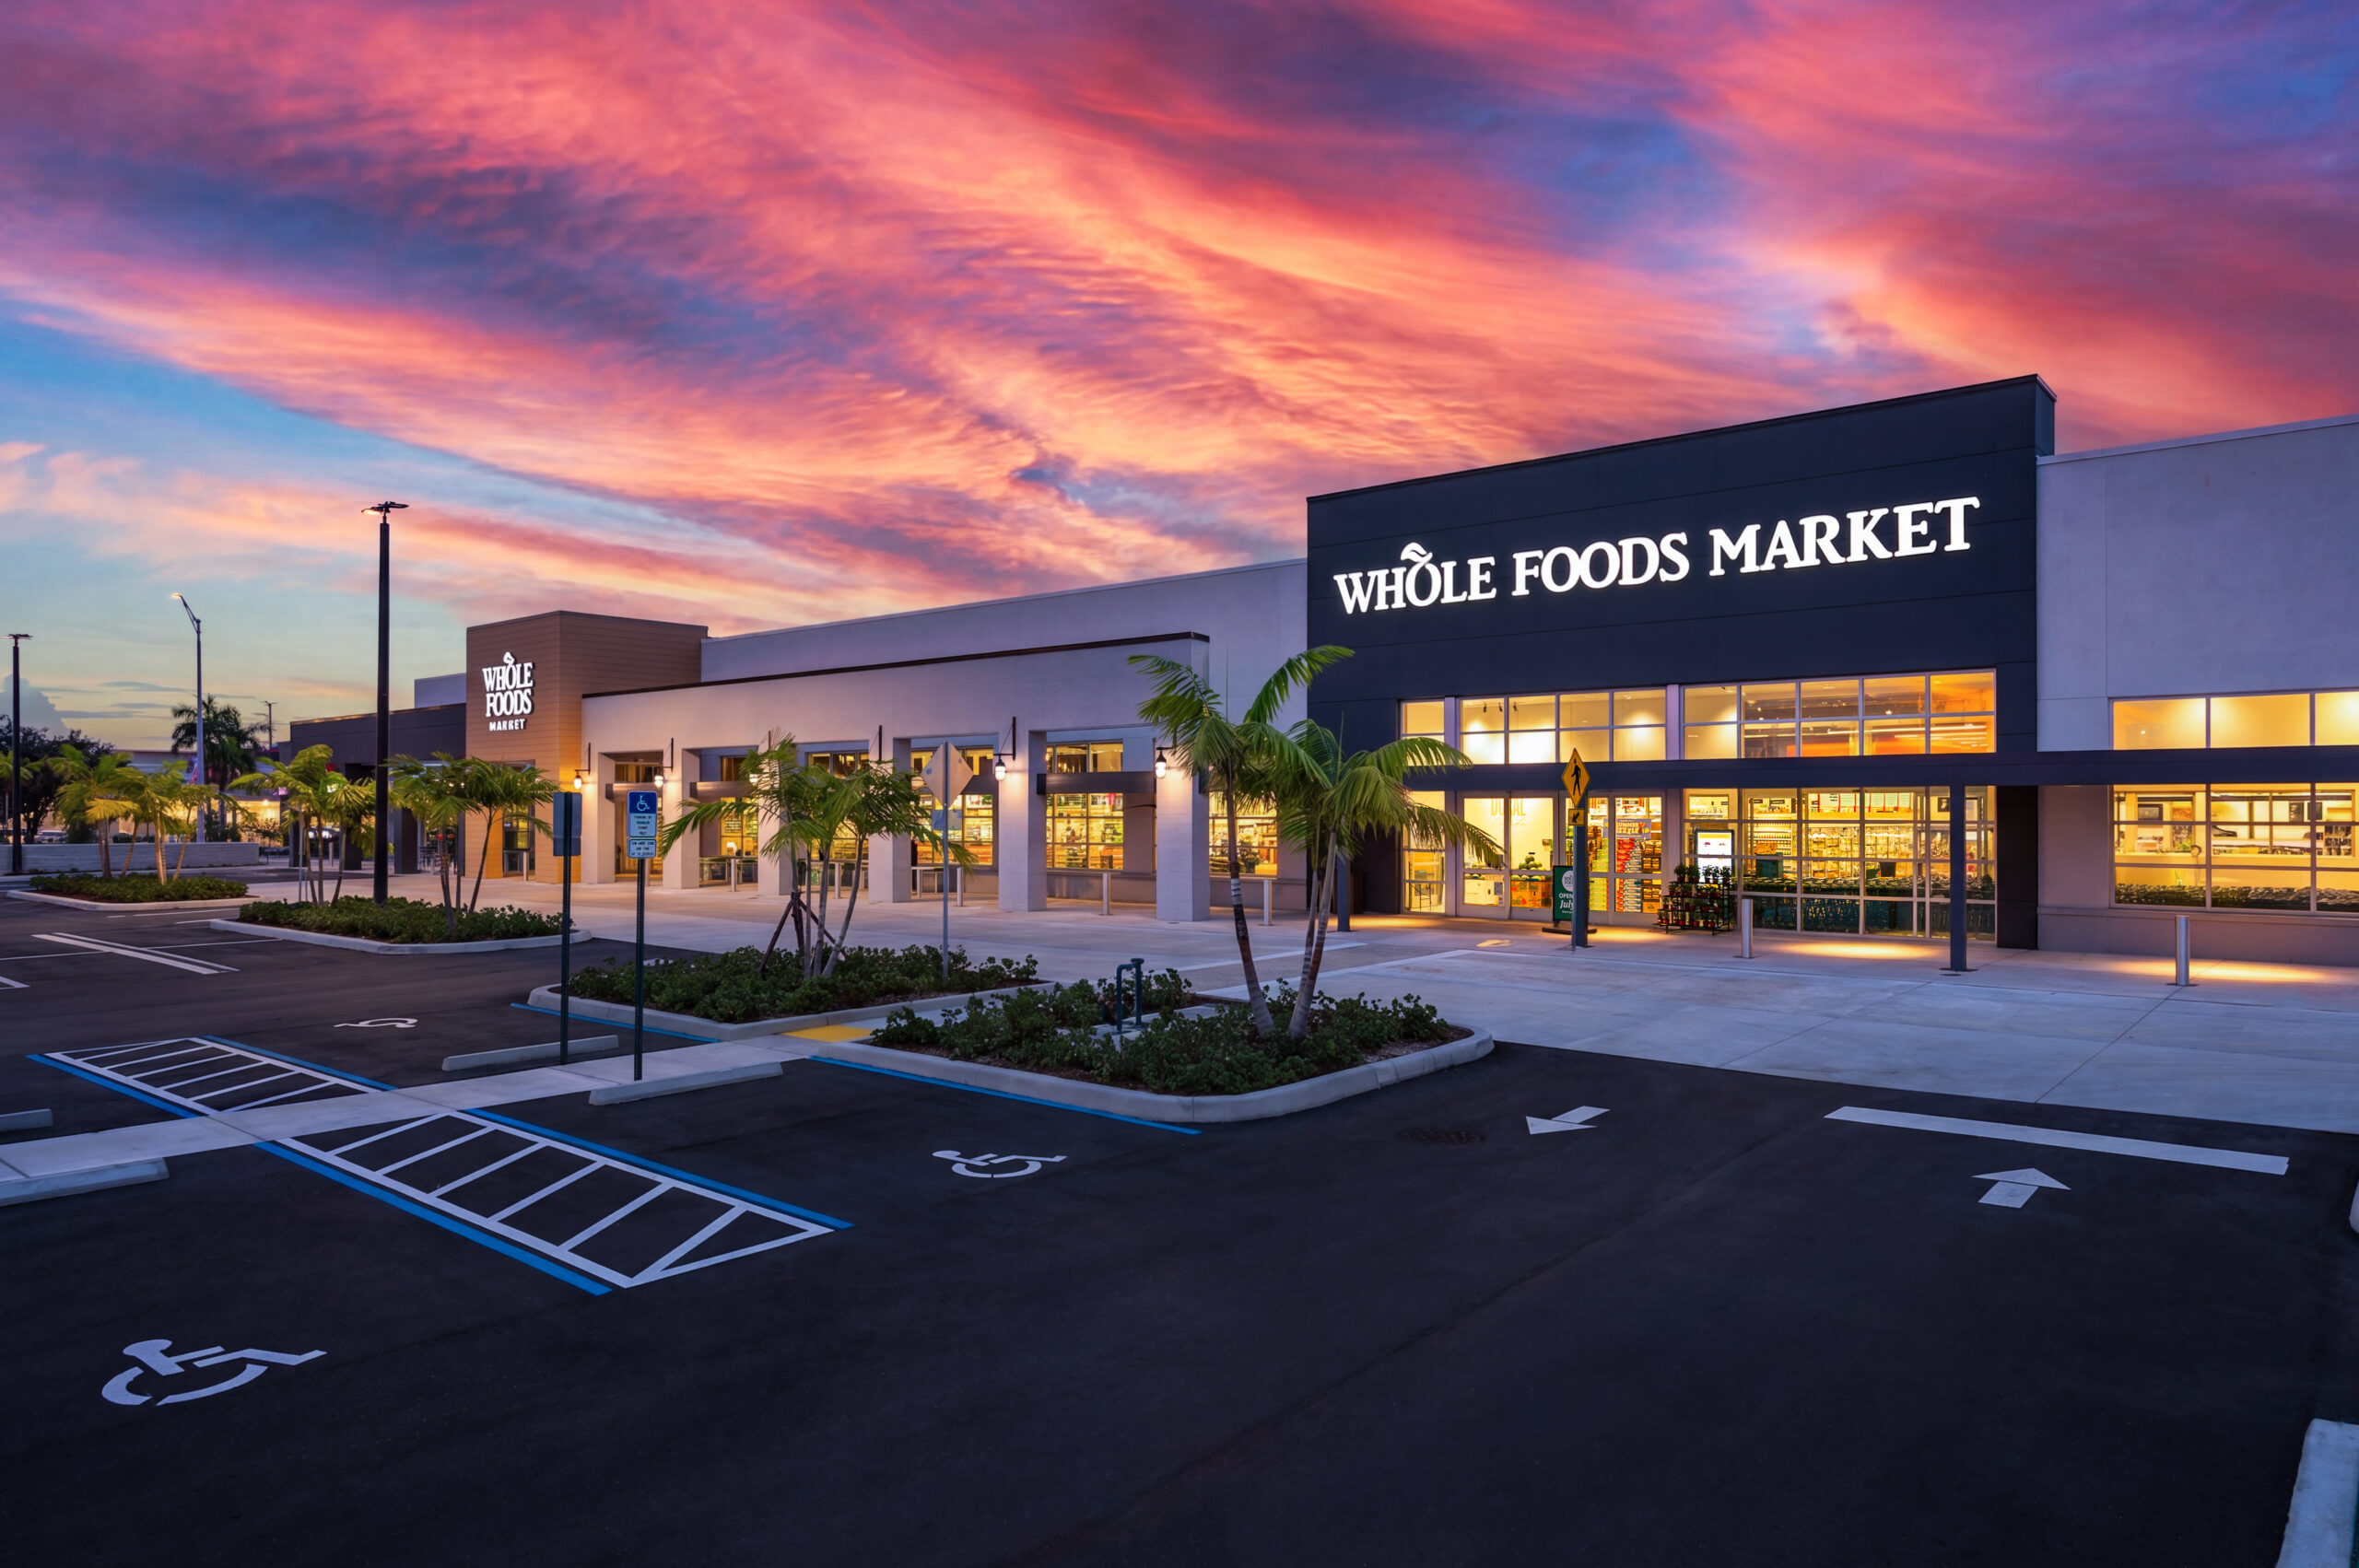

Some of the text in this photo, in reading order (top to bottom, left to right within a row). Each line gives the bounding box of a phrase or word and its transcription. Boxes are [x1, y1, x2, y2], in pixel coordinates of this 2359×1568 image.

[1332, 496, 1980, 614] WHOLE FOODS MARKET
[481, 658, 534, 692] WHOLE
[485, 688, 532, 718] FOODS
[488, 719, 525, 731] MARKET
